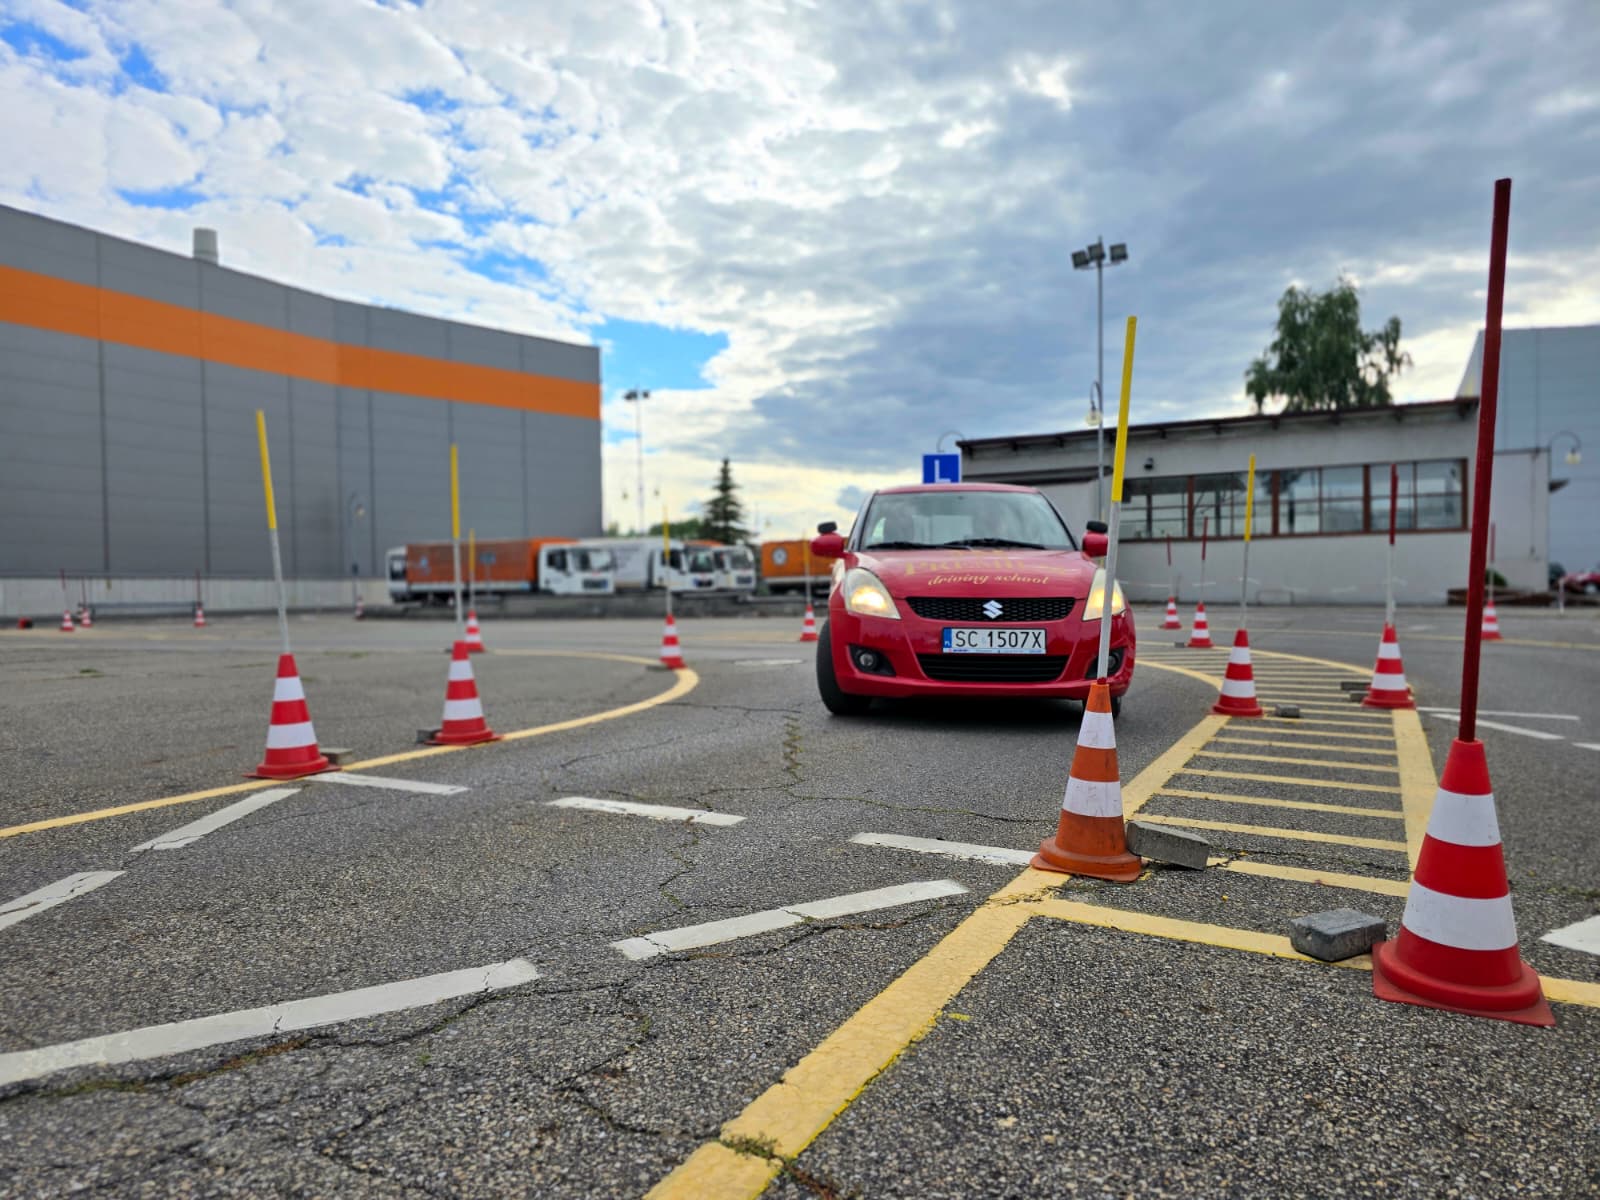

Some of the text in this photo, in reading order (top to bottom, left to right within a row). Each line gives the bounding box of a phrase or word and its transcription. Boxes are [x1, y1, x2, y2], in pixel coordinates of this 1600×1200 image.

[934, 459, 951, 483] L
[928, 573, 1049, 585] driving school
[955, 631, 1042, 649] SC 1507X
